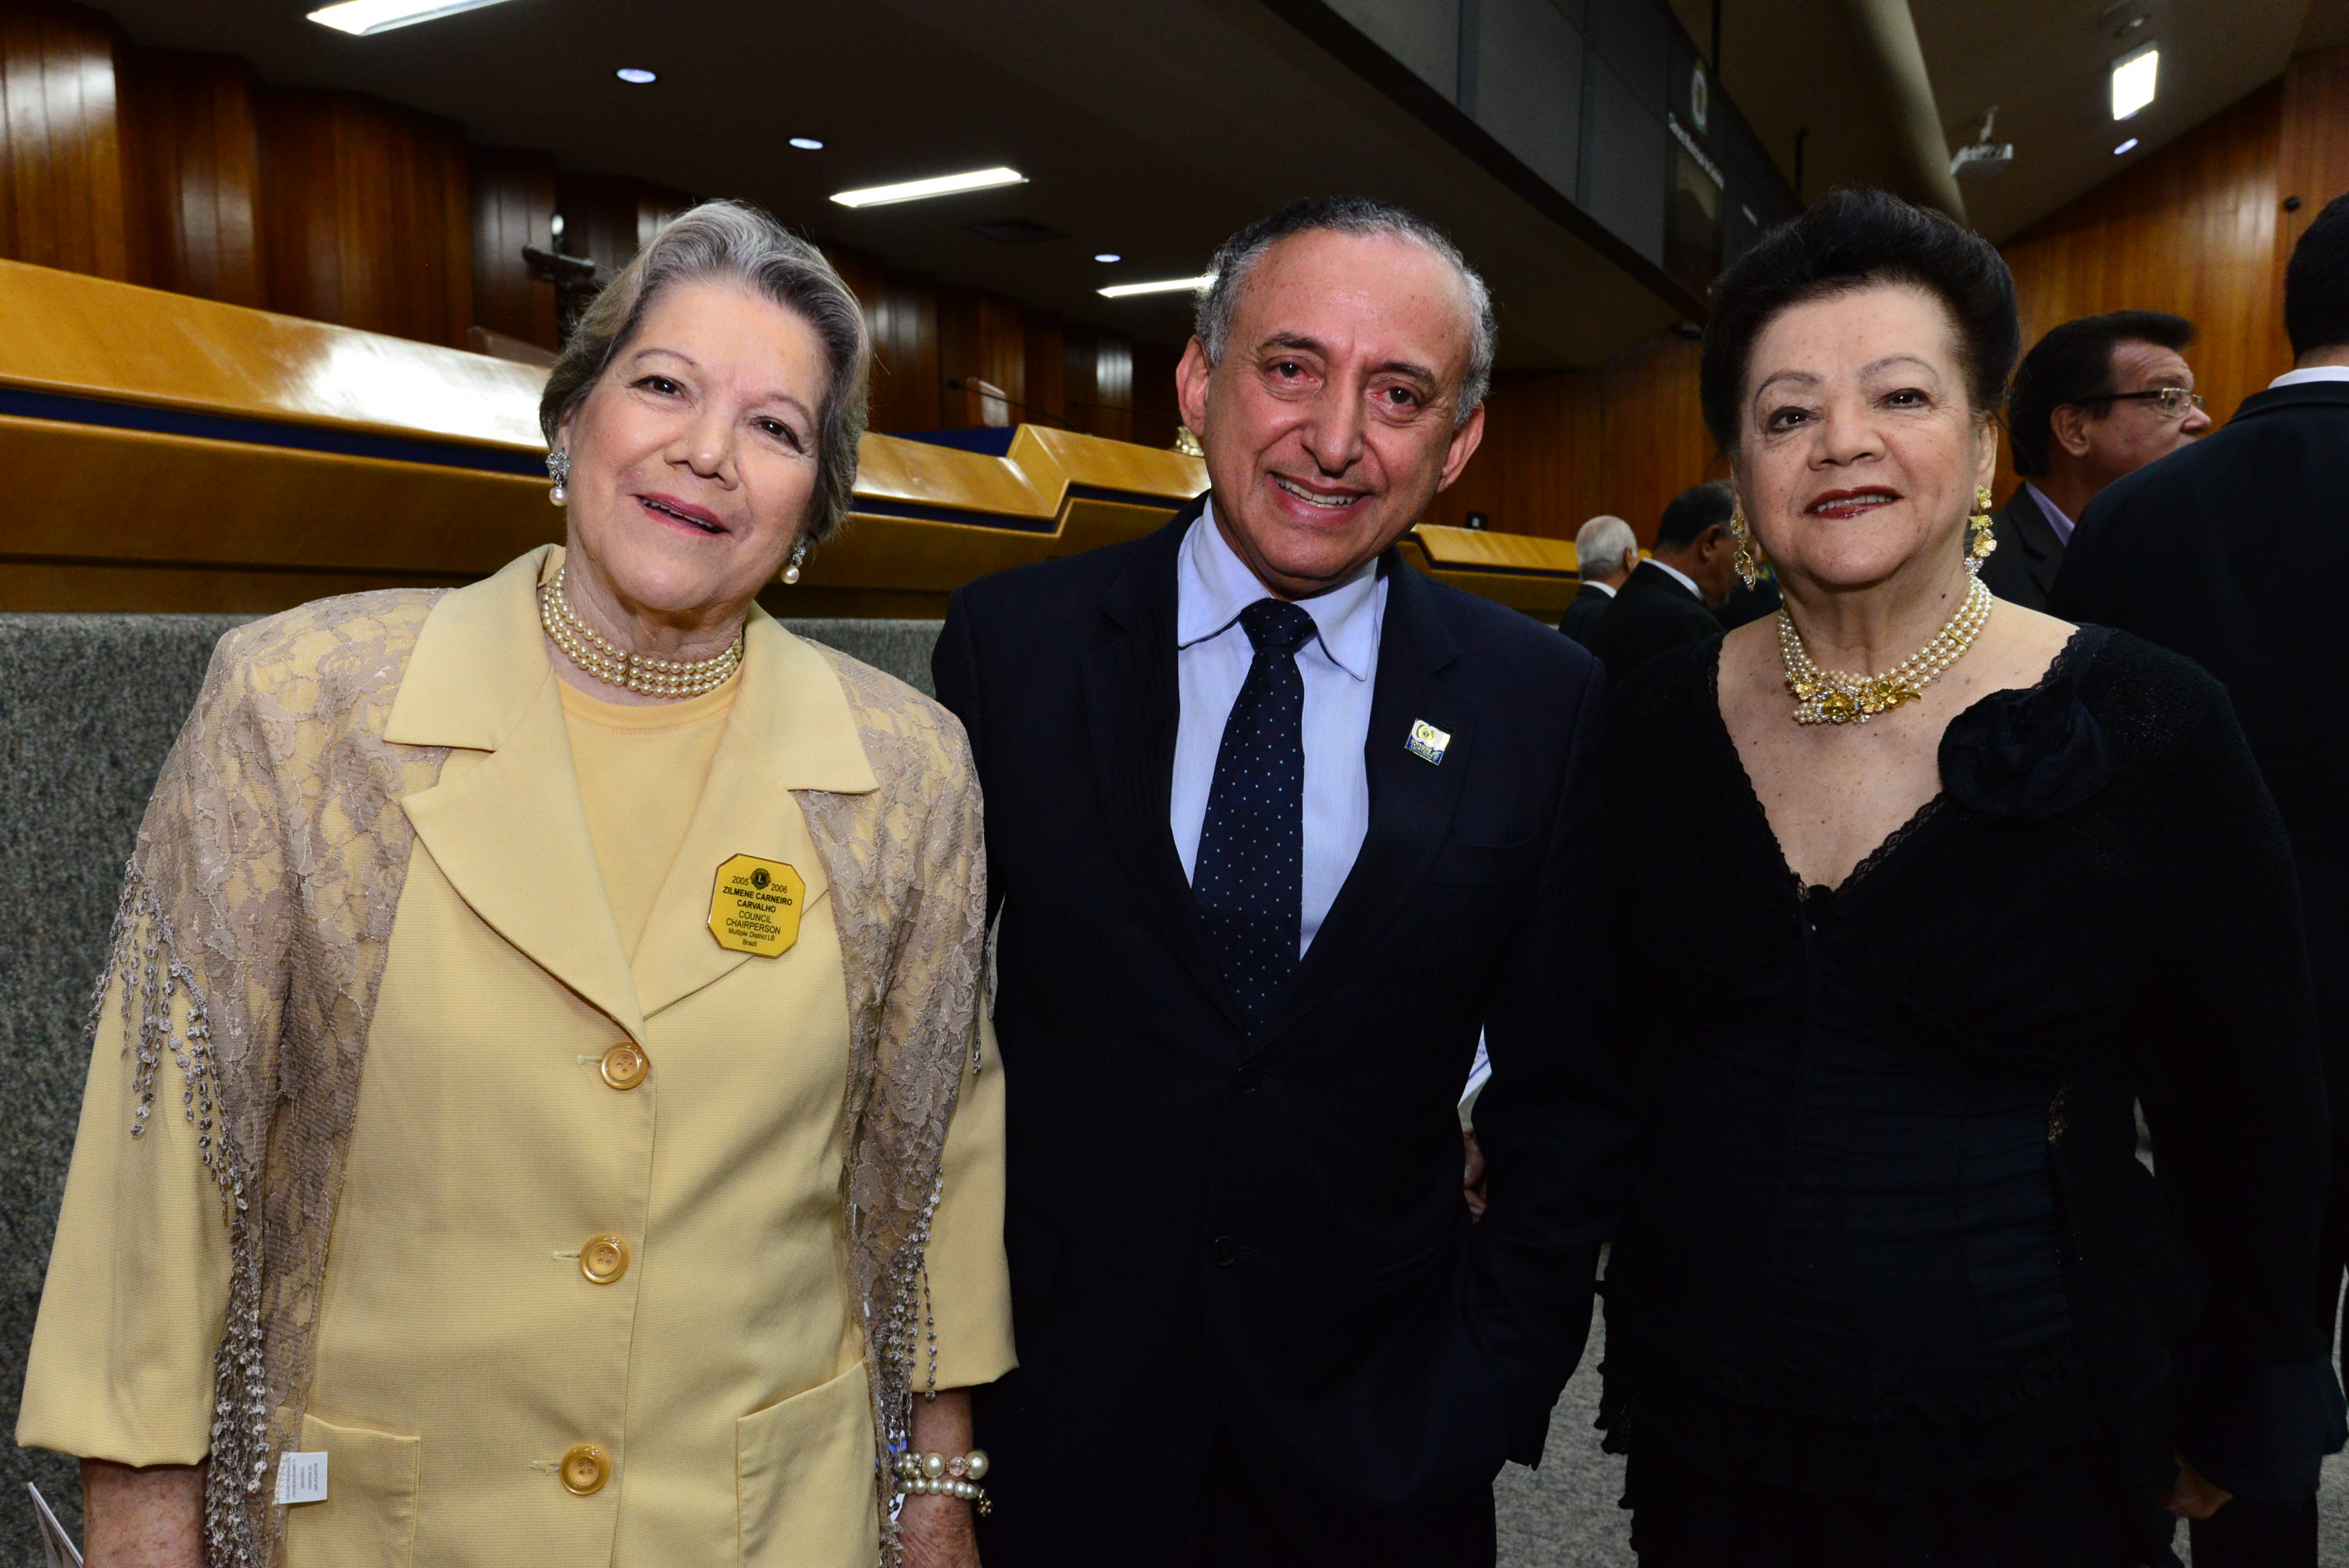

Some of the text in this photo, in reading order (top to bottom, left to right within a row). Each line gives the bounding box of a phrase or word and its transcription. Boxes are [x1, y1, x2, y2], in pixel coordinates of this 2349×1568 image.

[732, 875, 787, 893] 2005 2006
[722, 886, 793, 906] ZILMENE CARNEIRO
[736, 900, 776, 913] CARVALHO
[739, 911, 772, 923] COUNCIL
[725, 918, 781, 935] CHAIRPERSON
[728, 928, 748, 936] Multiple
